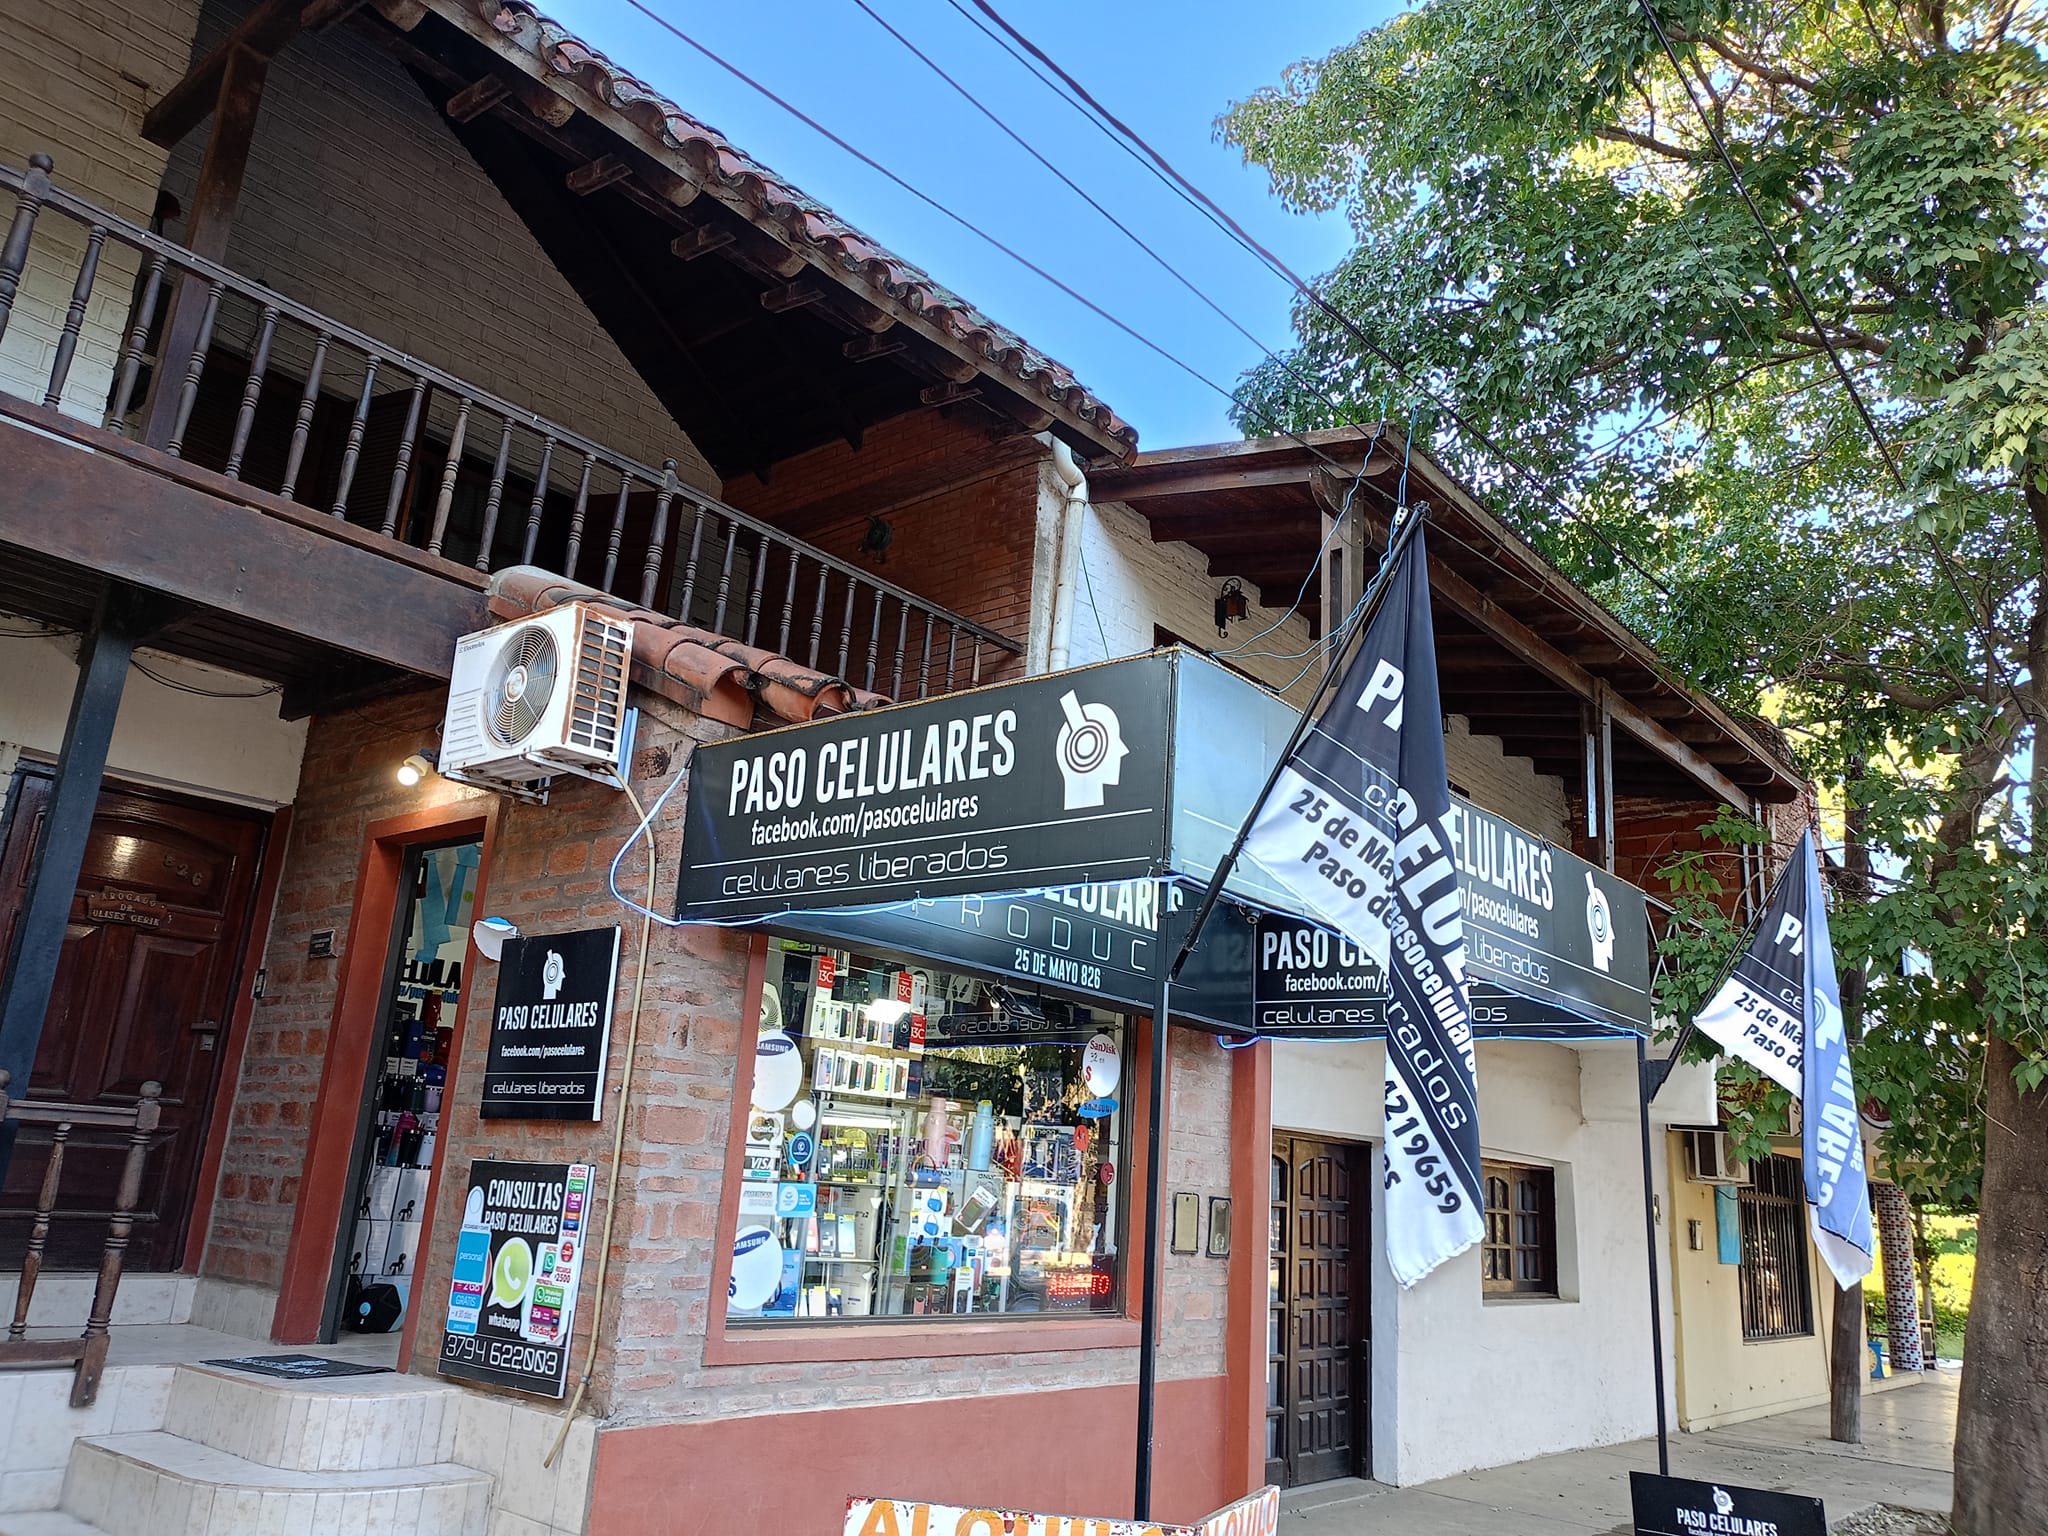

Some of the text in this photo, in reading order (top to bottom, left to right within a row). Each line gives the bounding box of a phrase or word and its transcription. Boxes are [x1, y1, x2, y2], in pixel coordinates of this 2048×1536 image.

[729, 709, 1017, 817] PASO CELULARES
[751, 793, 979, 846] facebook.com/pasocelulares
[1289, 789, 1329, 823] 25
[1323, 816, 1359, 849] de
[723, 841, 1008, 896] celulares liberados
[1301, 841, 1366, 899] Paso
[1447, 803, 1553, 911] ELULARES
[1263, 928, 1328, 970] PASO
[1474, 932, 1550, 985] liberados
[818, 970, 835, 983] 13C
[1014, 947, 1101, 989] 25 DE MAYO 826
[498, 1002, 598, 1030] PASO CELULARES
[1263, 1005, 1375, 1024] celulares
[1734, 992, 1758, 1013] 25
[1756, 1008, 1779, 1028] de
[756, 1041, 791, 1053] SAMSUNG
[911, 1027, 926, 1039] 13C
[1090, 1040, 1117, 1055] SanDisk
[1743, 1024, 1786, 1058] Paso
[501, 1044, 585, 1059] facebook.com/pasocelulares
[492, 1081, 585, 1094] celulares liberados
[751, 1157, 774, 1169] VISA
[487, 1179, 563, 1211] CONSULTAS
[485, 1211, 557, 1236] PASO CELULARES
[459, 1251, 484, 1263] personal
[455, 1295, 476, 1307] GRATIS
[488, 1312, 520, 1332] whatsapp
[446, 1335, 558, 1375] 3794 622003
[1676, 1507, 1707, 1528] PASO
[1709, 1513, 1778, 1536] CELULARES
